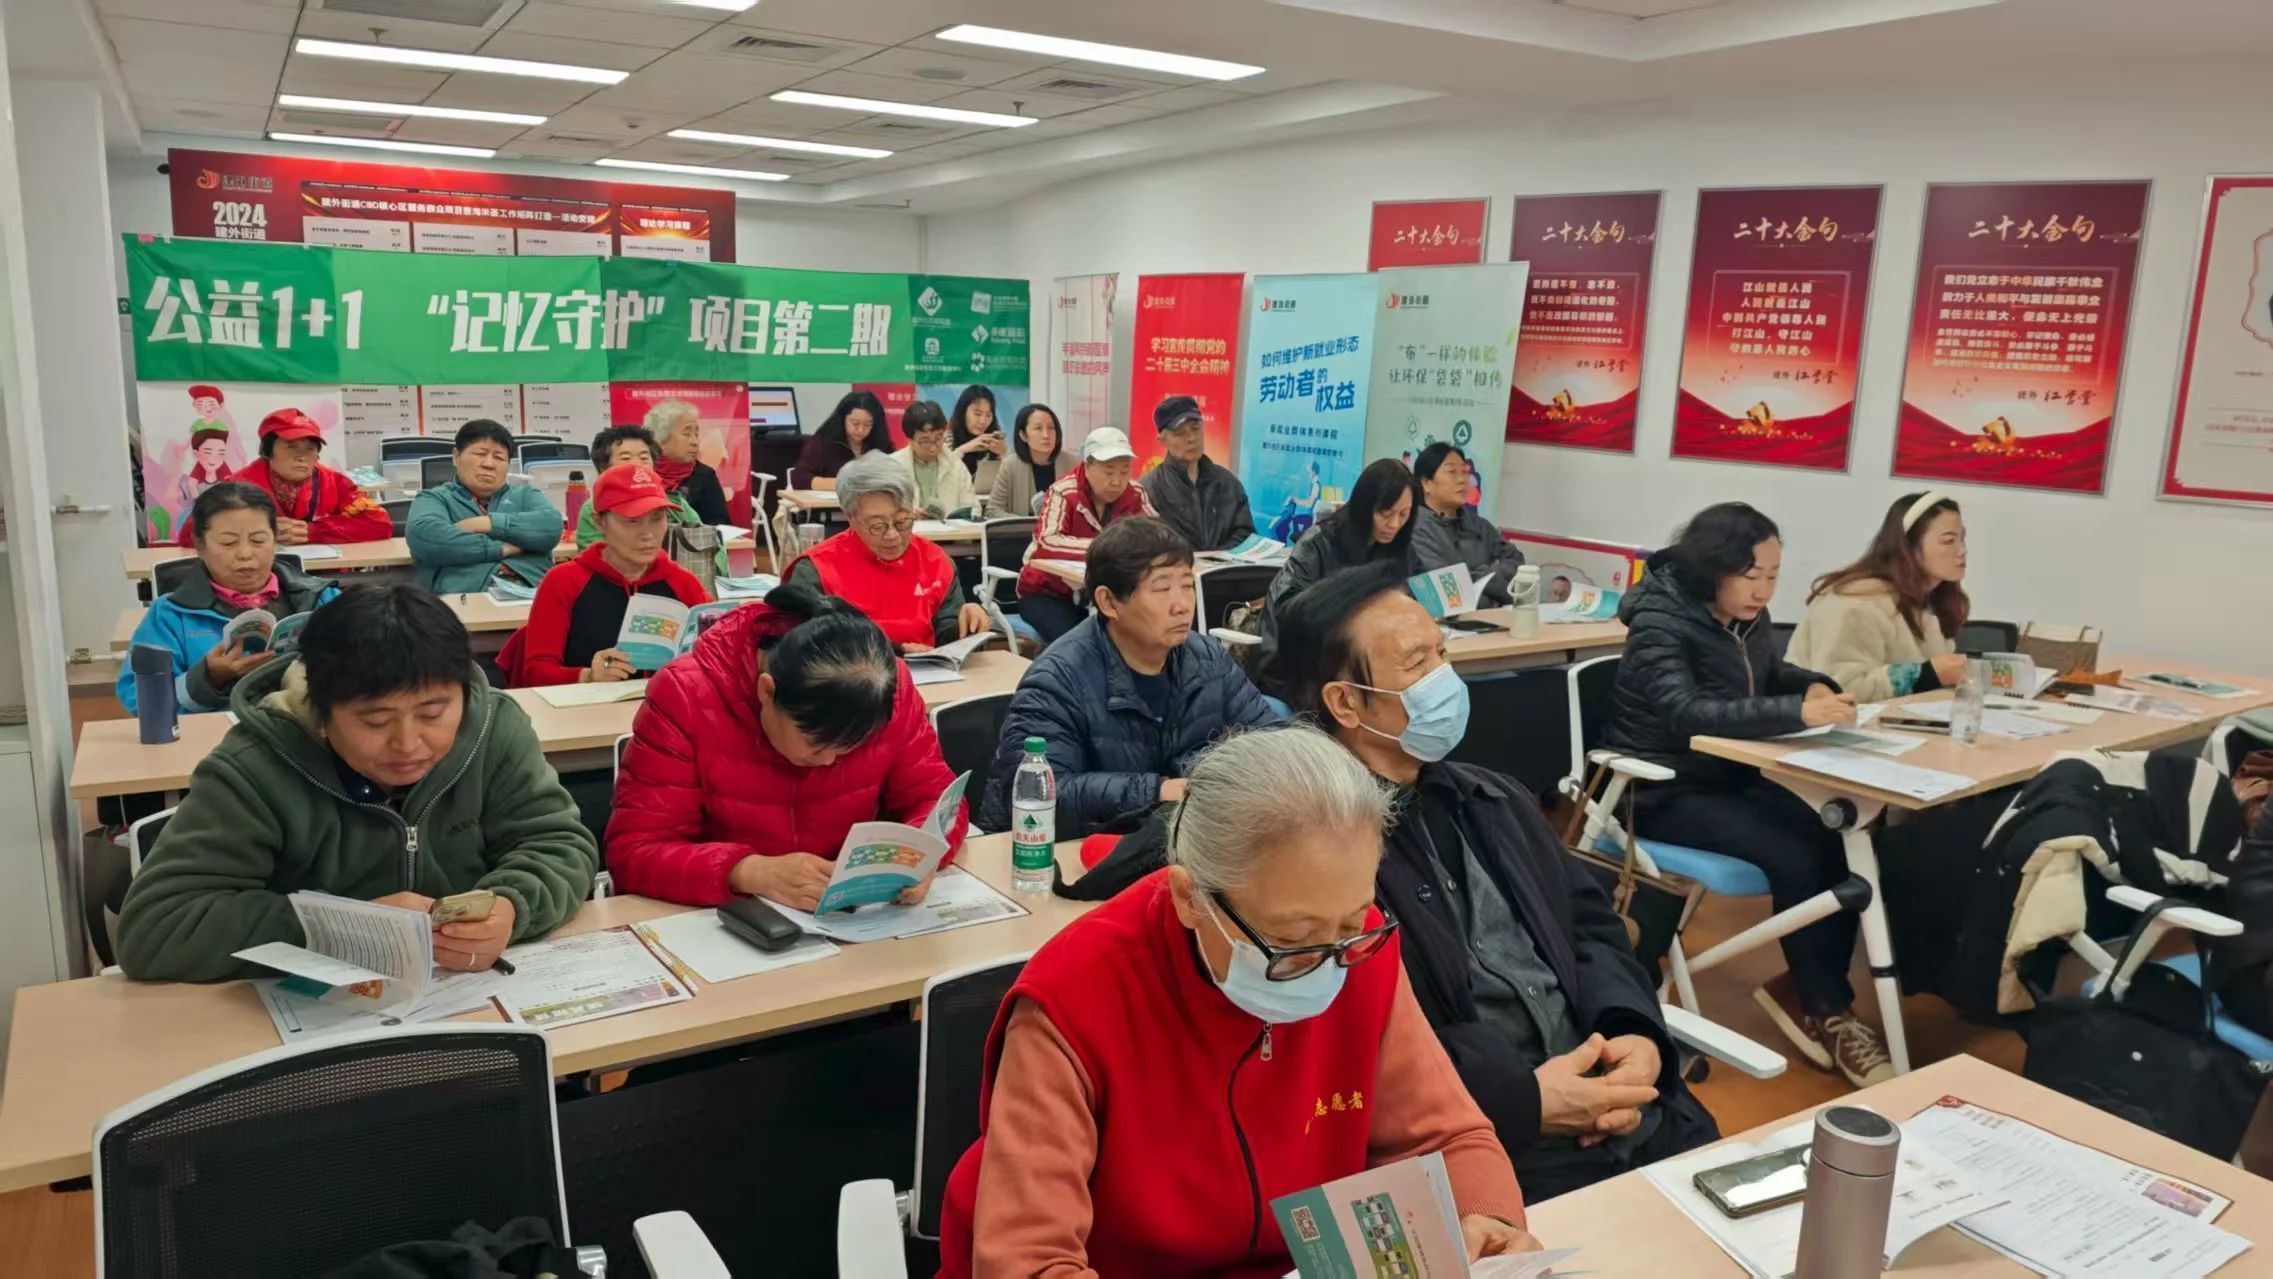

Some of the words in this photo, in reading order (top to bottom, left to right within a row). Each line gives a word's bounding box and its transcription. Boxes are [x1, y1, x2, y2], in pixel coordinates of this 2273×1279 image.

[212, 200, 268, 227] 2024
[214, 226, 266, 240] 建外街道
[1394, 223, 1459, 247] 二十大金句
[1541, 219, 1626, 245] 二十大金句
[1732, 216, 1839, 242] 二十大金句
[1968, 214, 2096, 242] 二十大金句
[143, 275, 364, 351] 公益1+1
[427, 289, 665, 354] “记忆守护”
[688, 296, 892, 357] 项目第二期
[1260, 335, 1360, 368] 如何维护新就业形态
[1145, 356, 1230, 375] 二十届三中全会精神
[1314, 380, 1356, 413] 权益
[1313, 1090, 1365, 1118] 志愿者
